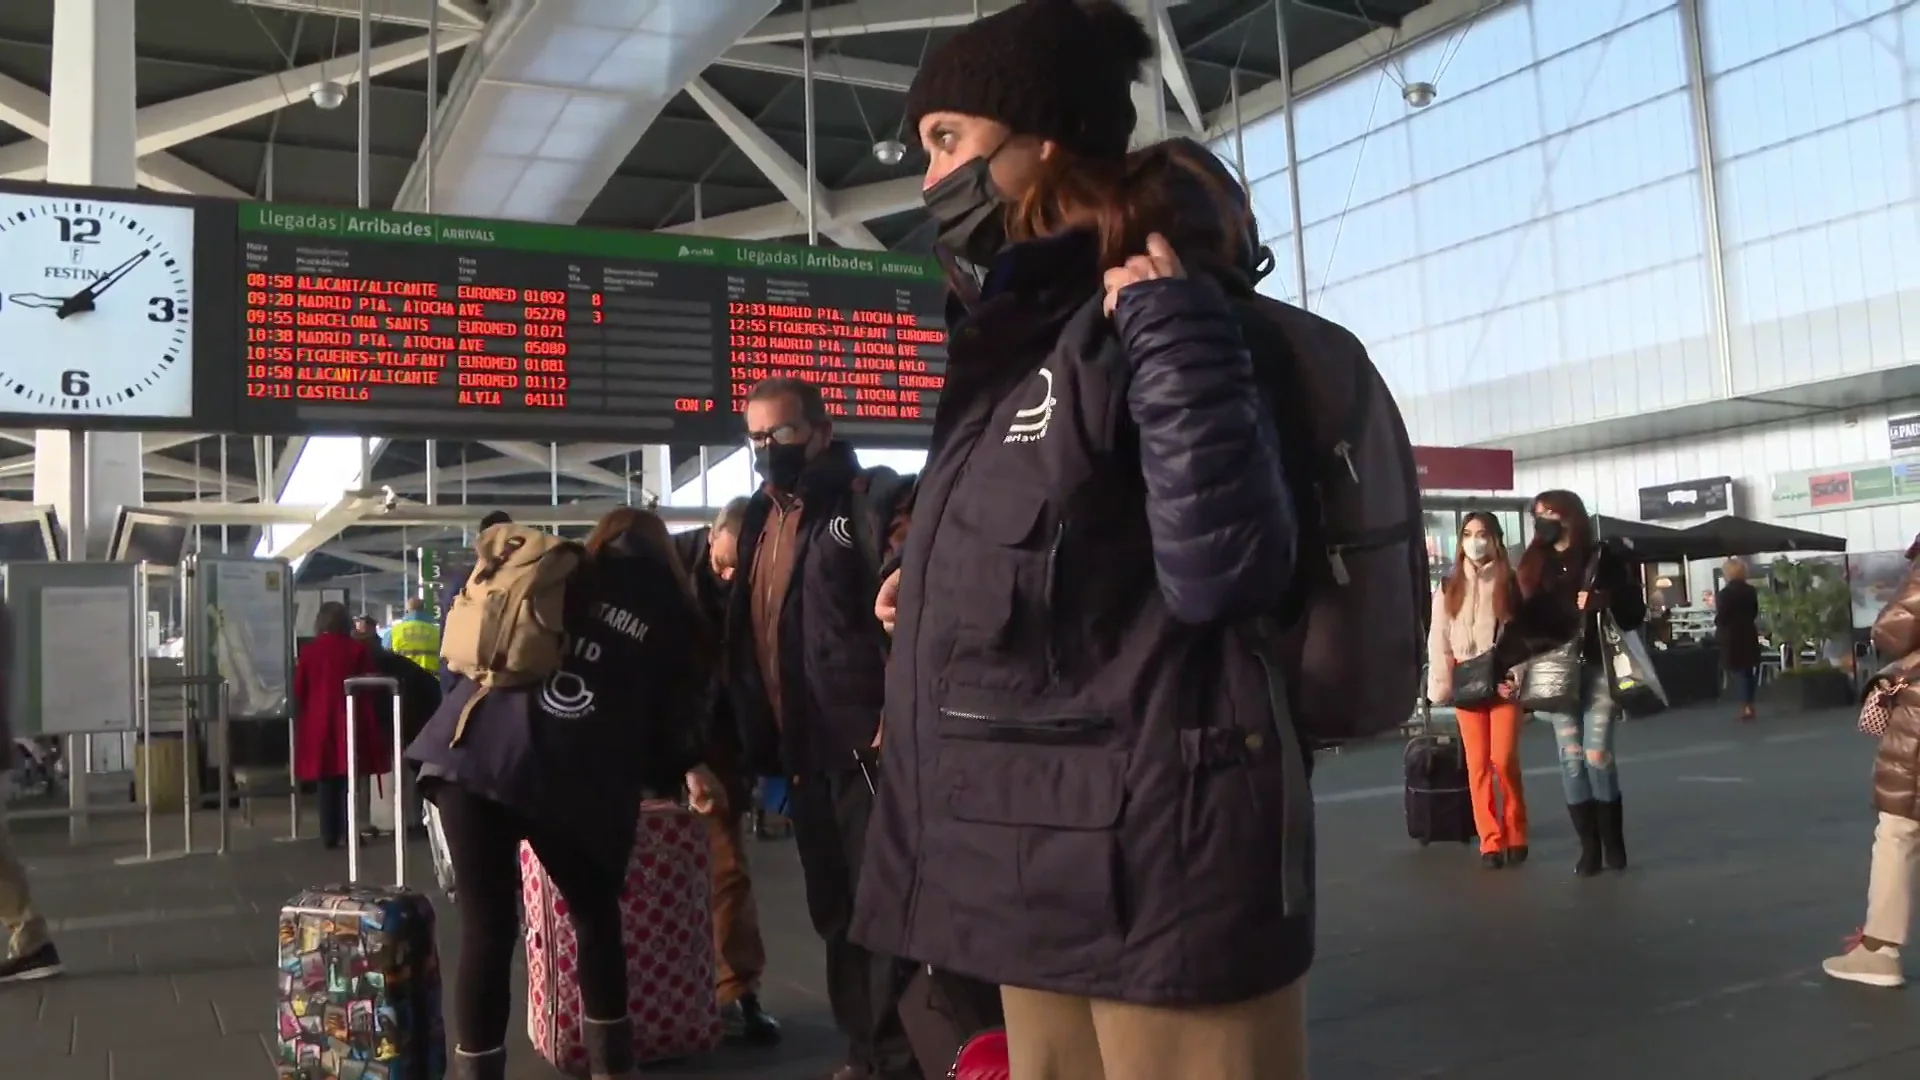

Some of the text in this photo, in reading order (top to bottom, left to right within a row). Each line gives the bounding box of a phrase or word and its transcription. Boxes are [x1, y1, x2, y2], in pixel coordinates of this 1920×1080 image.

[54, 216, 102, 244] 12
[259, 209, 495, 241] Llegadas Arribades ARRIVALS
[736, 248, 923, 275] Llegadas Arribades ARRIVALS
[44, 267, 111, 281] FESTINA
[297, 276, 438, 298] ALACANT/ALICANTE
[458, 286, 517, 302] EUROMED
[148, 297, 175, 322] 3
[247, 291, 294, 306] 09:20
[297, 294, 352, 310] MADRID
[360, 297, 392, 312] PTA.
[403, 299, 455, 316] ATOCHA
[459, 303, 485, 318] AVE
[592, 310, 601, 324] 3
[729, 303, 917, 326] 12:33 MADRID PTA. ATOCHA AVE
[247, 309, 294, 324] 09:55
[297, 312, 378, 329] BARCELONA
[385, 317, 429, 332] SANTS
[458, 320, 517, 336] EUROMED
[730, 319, 943, 342] 12:55 FIGUERES-VILAFANT EUROMED
[297, 330, 352, 346] MADRID
[360, 333, 393, 348] PTA.
[403, 335, 455, 351] ATOCHA
[459, 338, 485, 352] AVE
[730, 335, 918, 356] 13:20 MADRID PTA. ATOCHA AVE
[297, 347, 446, 368] FIGUERES-VILAFANT
[458, 355, 518, 371] EUROMED
[730, 351, 926, 372] 14:33 MADRID PTA. ATOCHA AVLO
[61, 370, 90, 396] 6
[297, 367, 439, 385] ALACANT/ALICANTE
[459, 373, 518, 388] EUROMED
[525, 375, 567, 390] 01112
[731, 367, 768, 380] 15:04
[898, 375, 945, 388] EUROMED
[247, 383, 294, 398] 12:11
[459, 390, 501, 405] ALVIA
[525, 393, 565, 407] 04111
[675, 399, 699, 412] CON
[705, 399, 714, 412] P
[821, 387, 847, 400] PTA.
[856, 388, 897, 401] ATOCHA
[900, 390, 920, 403] AVE
[856, 404, 898, 417] ATOCHA
[900, 406, 921, 418] AVE
[1899, 422, 1920, 438] PAU
[599, 602, 649, 642] TARIAN
[574, 637, 602, 662] ID
